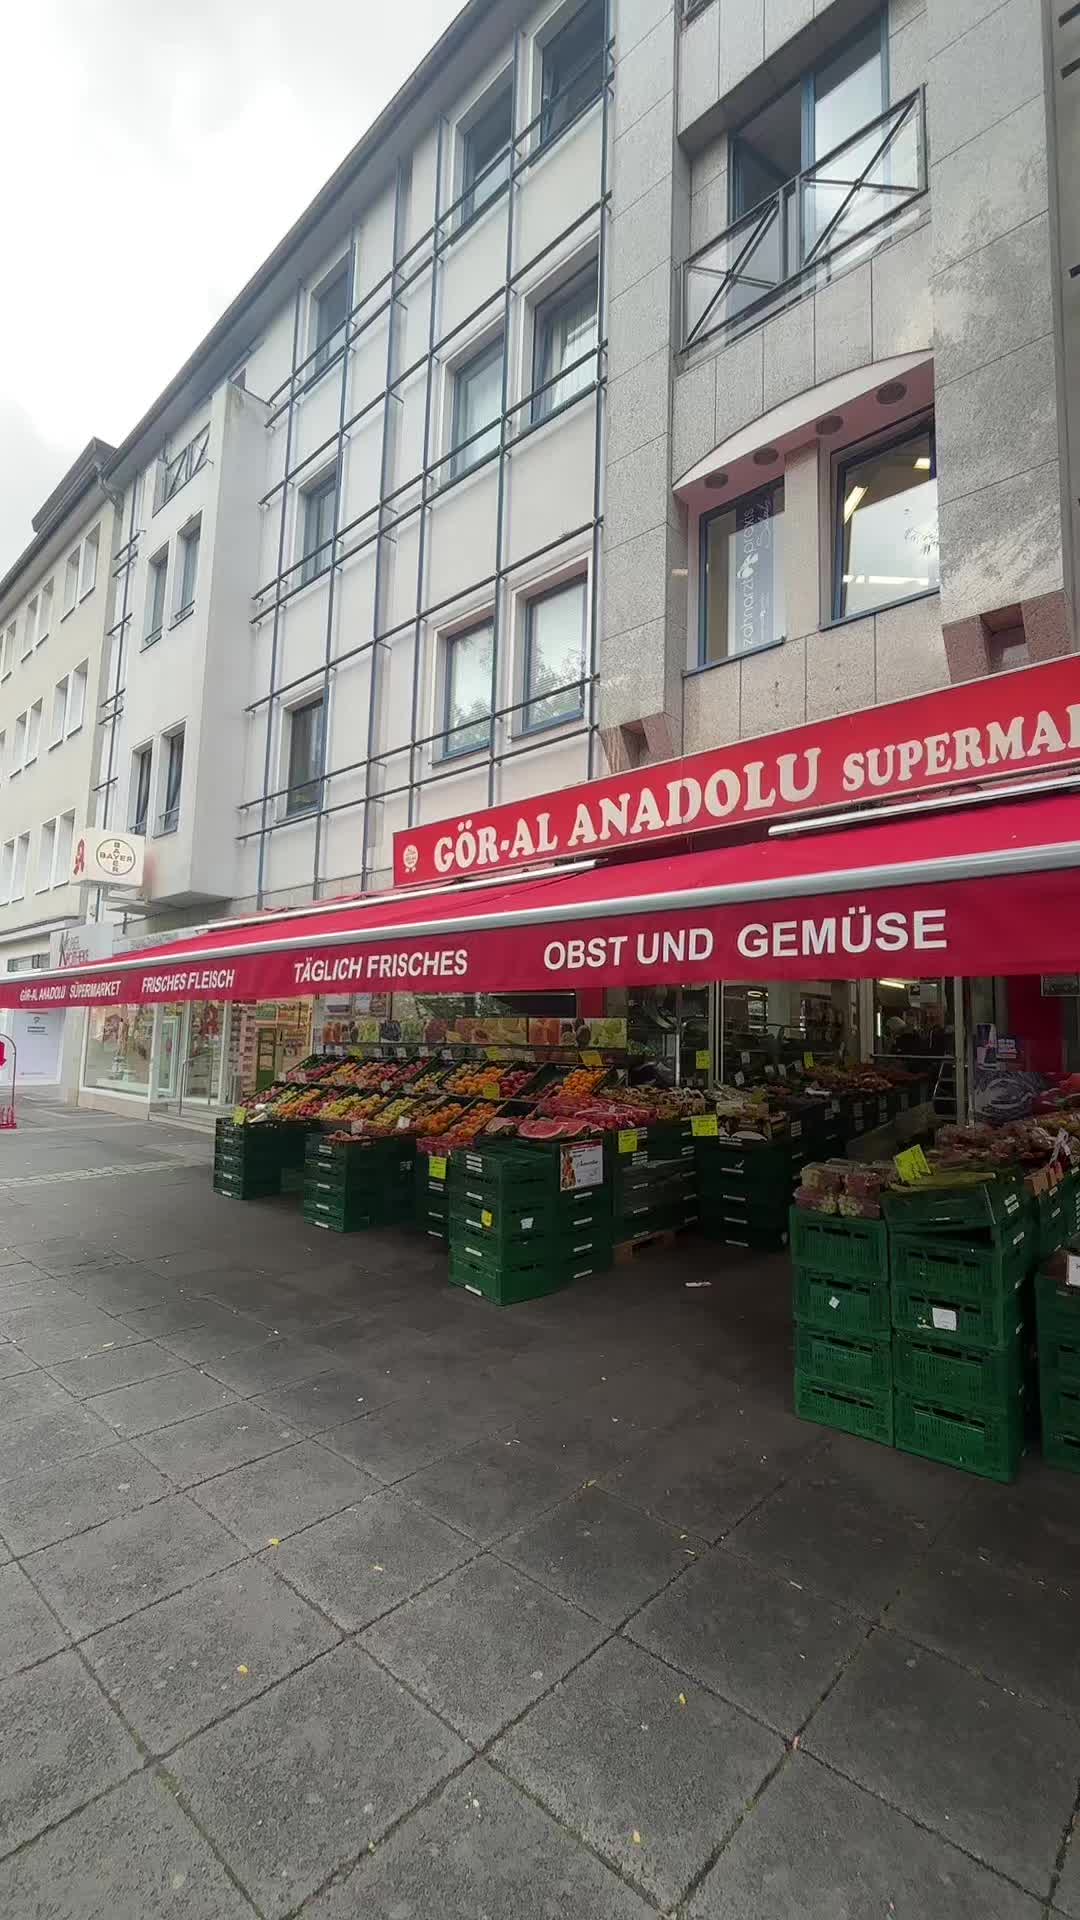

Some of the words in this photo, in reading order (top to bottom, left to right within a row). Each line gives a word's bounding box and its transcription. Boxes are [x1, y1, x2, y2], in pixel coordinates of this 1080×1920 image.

[433, 812, 558, 873] GÖR-AL
[567, 747, 821, 846] ANADOLU
[543, 935, 628, 970] OBST
[636, 928, 714, 965] UND
[737, 906, 947, 958] GEMÜSE
[141, 972, 187, 993] FRISCHES
[187, 968, 236, 990] FLEISCH
[294, 956, 363, 984] TÄGLICH
[367, 949, 469, 979] FRISCHES
[39, 985, 67, 1001] ANADOLU
